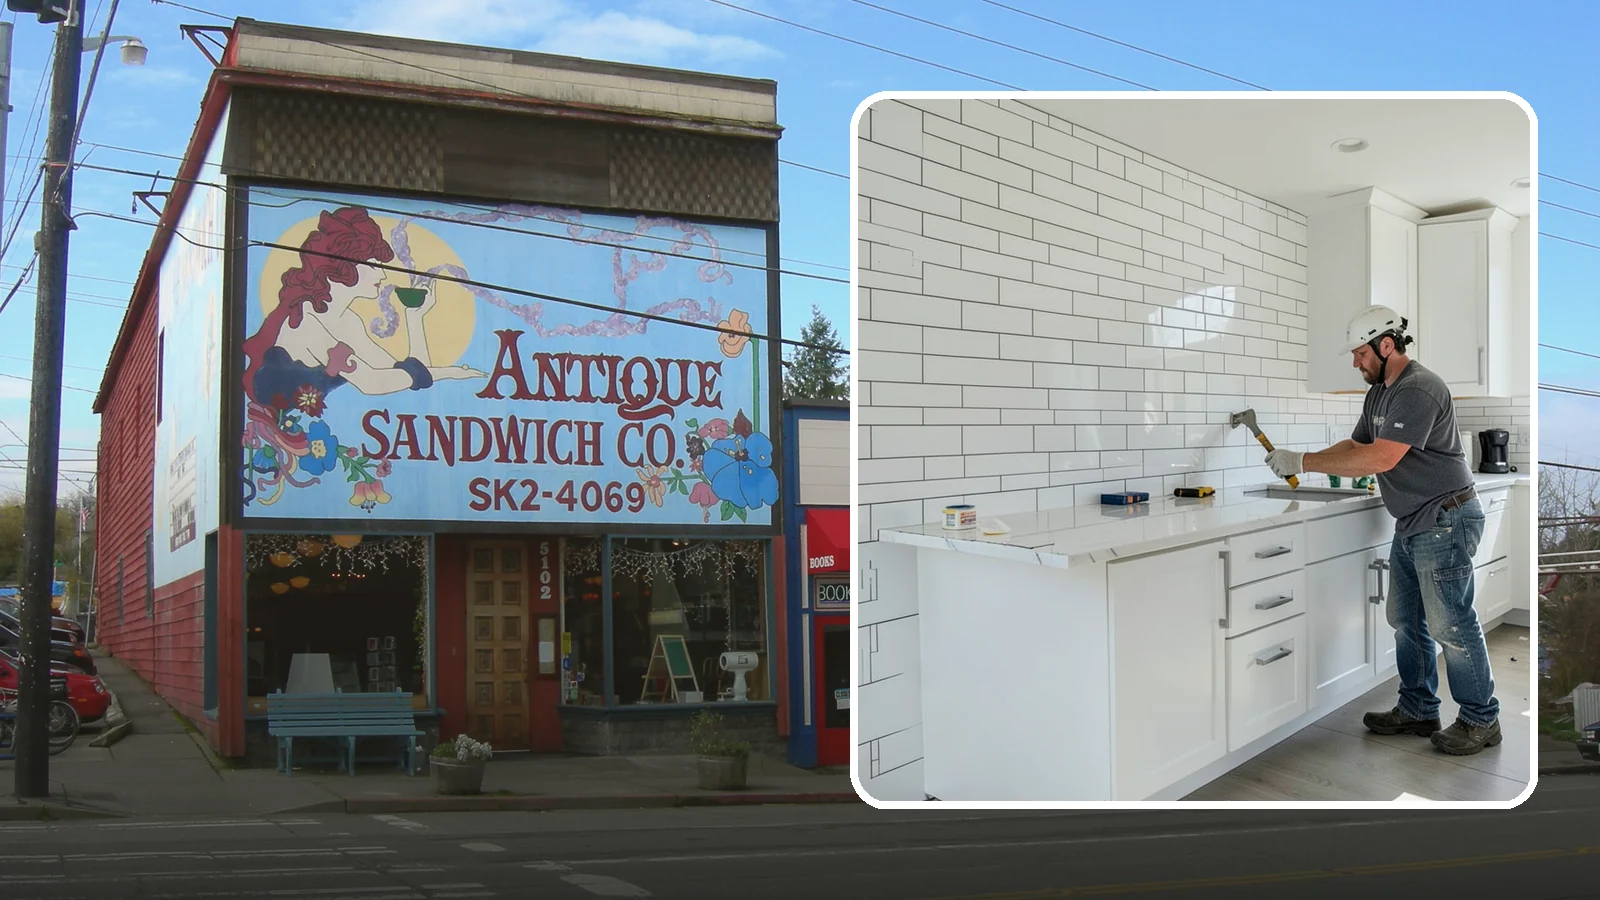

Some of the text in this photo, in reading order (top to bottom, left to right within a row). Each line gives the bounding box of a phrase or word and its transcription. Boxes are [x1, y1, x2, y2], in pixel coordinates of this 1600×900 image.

[476, 329, 723, 420] ANTIQUE
[361, 409, 684, 468] SANDWICH CO.
[468, 477, 645, 513] SK2-4069
[539, 541, 552, 599] 5102
[809, 555, 834, 569] BOOKS
